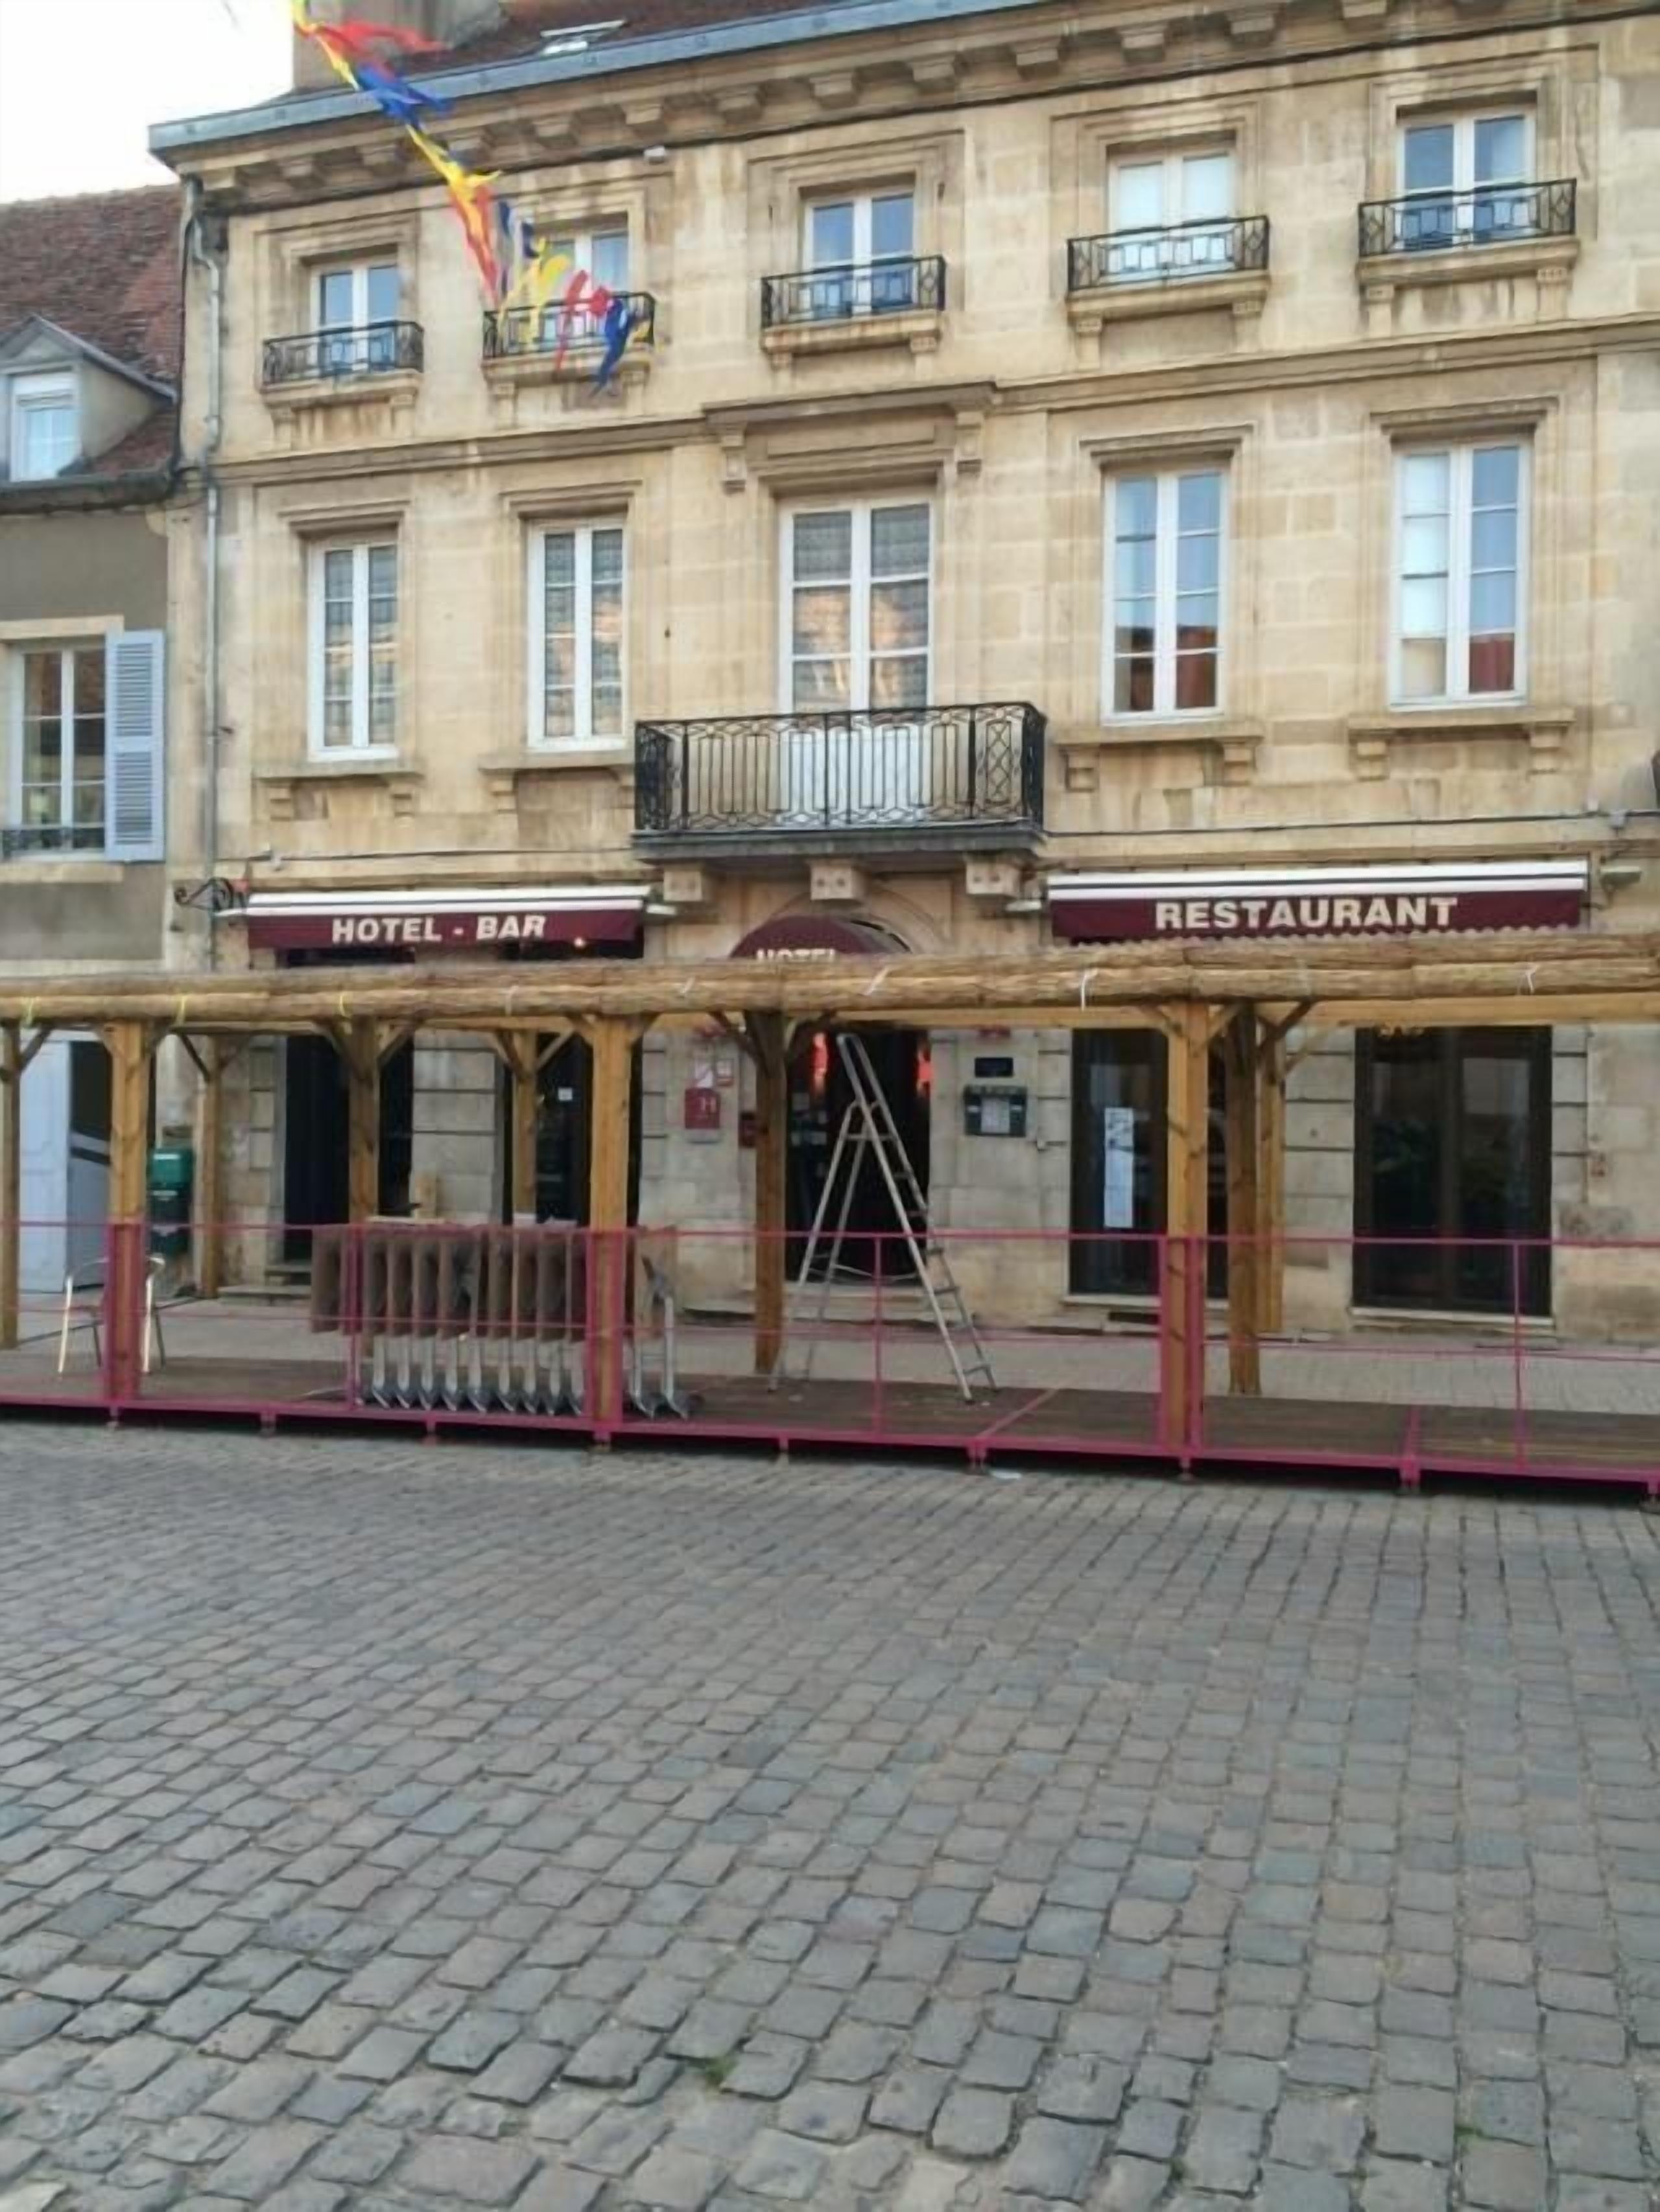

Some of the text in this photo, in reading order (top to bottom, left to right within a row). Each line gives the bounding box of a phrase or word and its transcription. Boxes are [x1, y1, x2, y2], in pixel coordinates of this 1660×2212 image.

[332, 917, 442, 943] HOTEL
[476, 914, 546, 940] BAR
[1155, 897, 1458, 930] RESTAURANT
